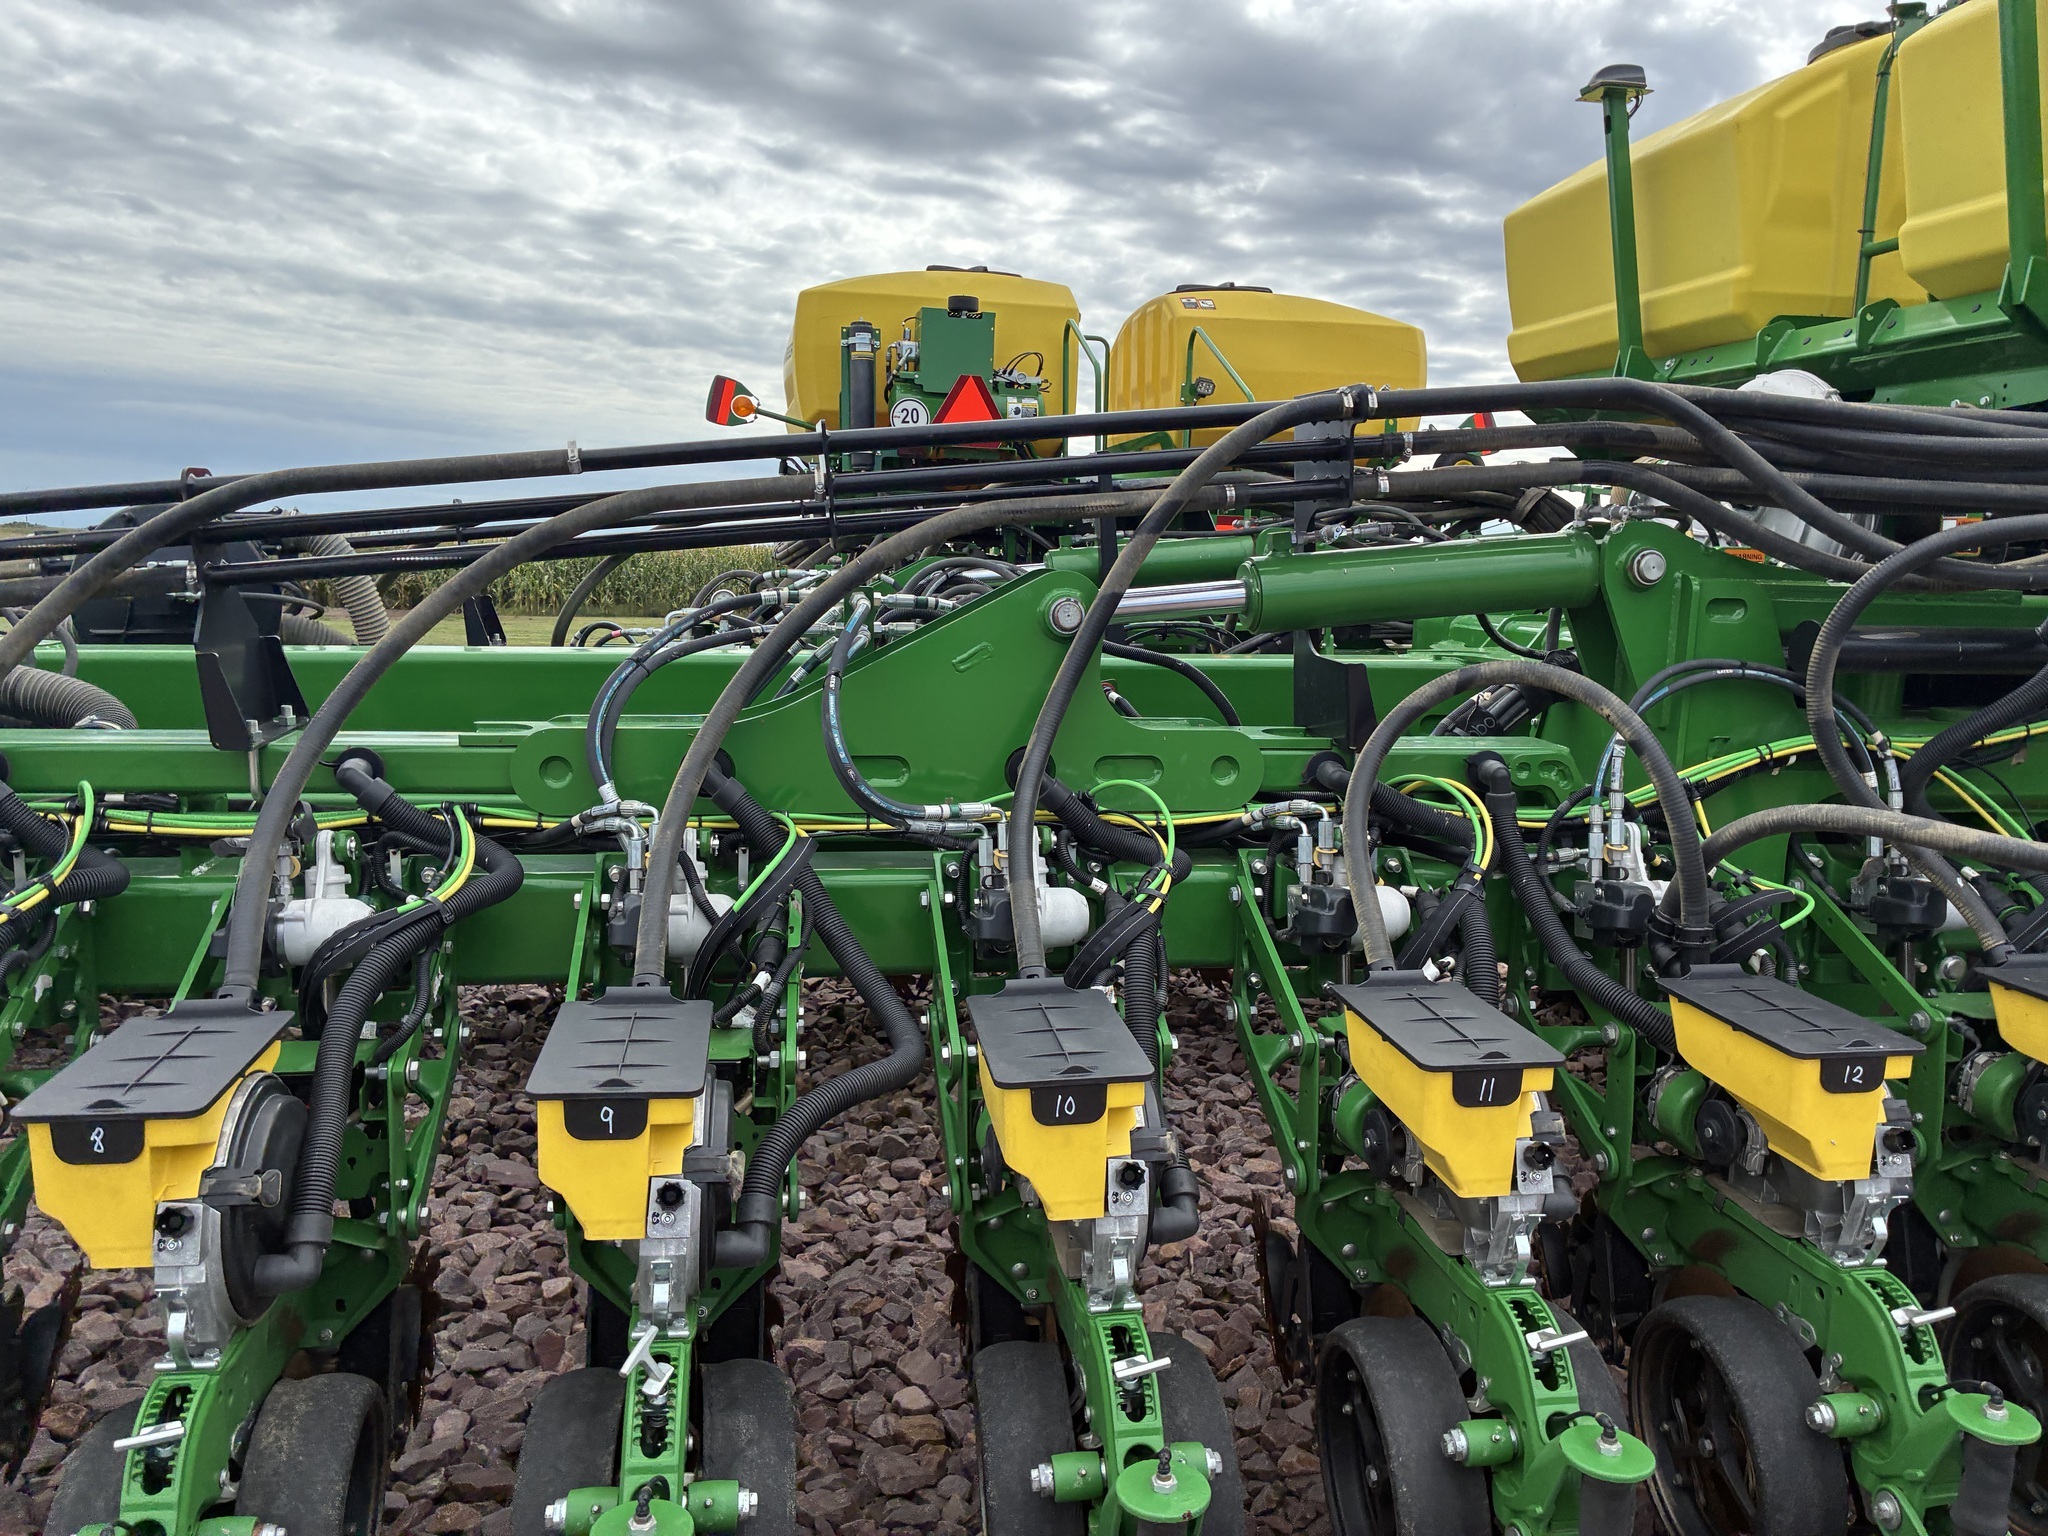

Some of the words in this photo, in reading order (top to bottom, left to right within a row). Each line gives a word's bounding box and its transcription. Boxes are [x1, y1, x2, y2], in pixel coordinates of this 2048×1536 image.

[901, 408, 919, 424] 20
[1844, 1064, 1864, 1084] 12
[1479, 1077, 1495, 1102] 11
[1055, 1094, 1076, 1118] 10
[600, 1106, 614, 1134] 9
[90, 1126, 104, 1154] 8
